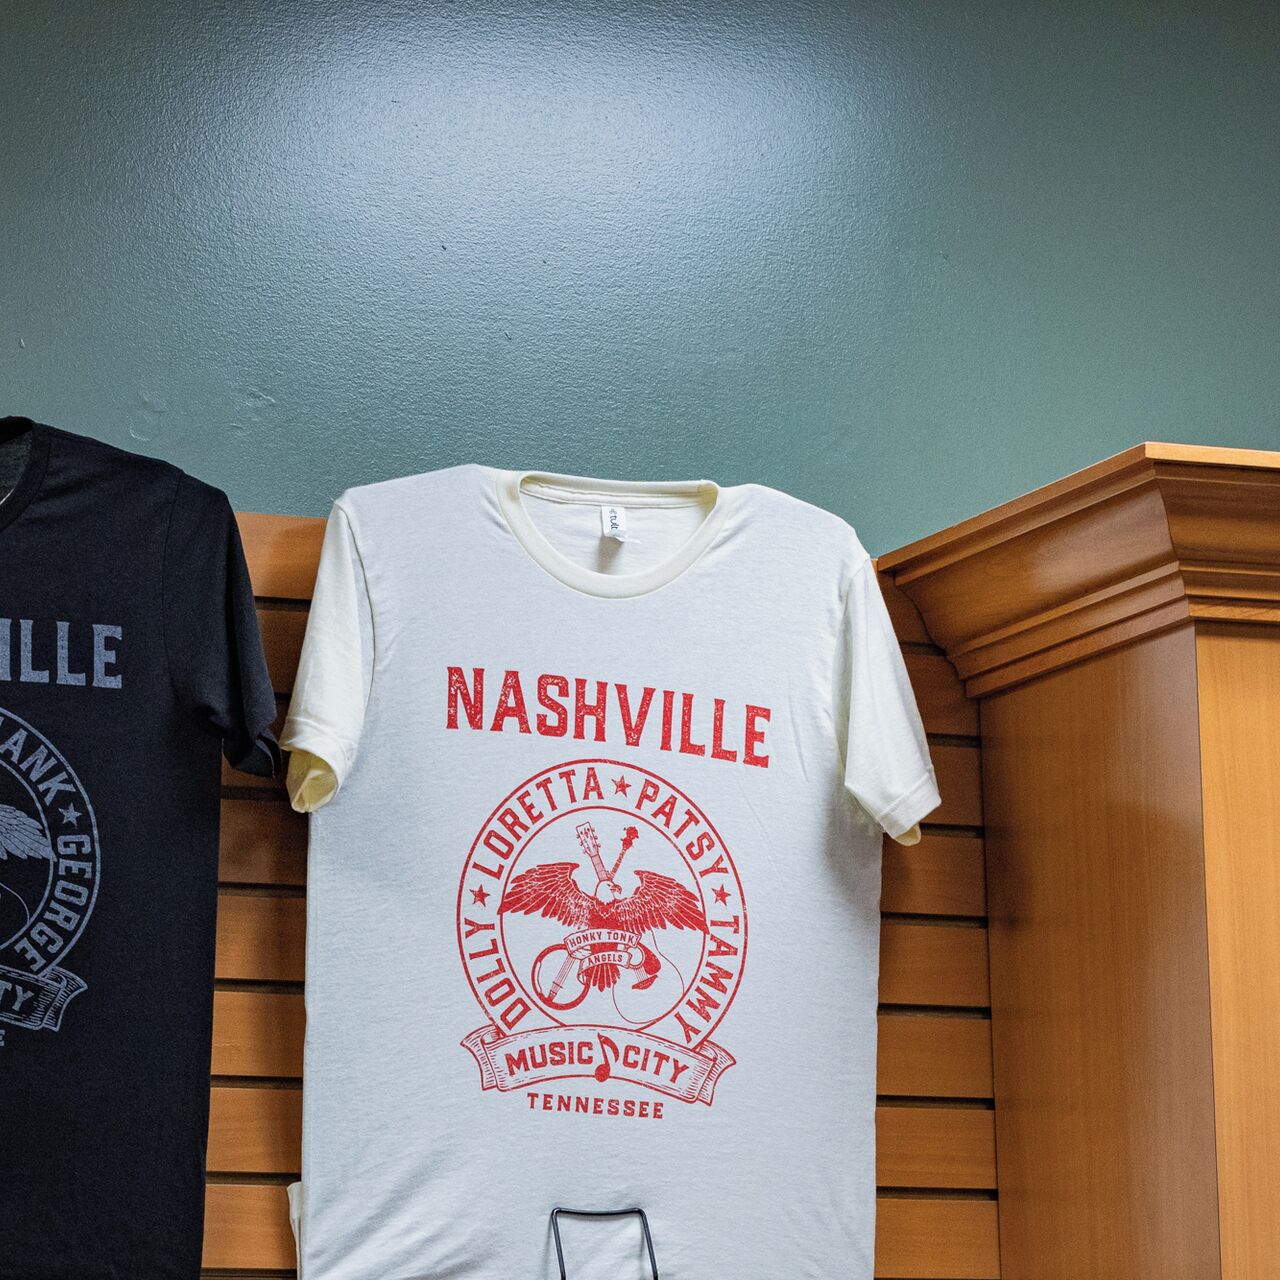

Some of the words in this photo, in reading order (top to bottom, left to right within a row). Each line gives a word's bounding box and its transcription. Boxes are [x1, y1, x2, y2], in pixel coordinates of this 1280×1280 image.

[446, 666, 771, 768] NASHVILLE
[472, 767, 604, 880] LORETTA
[635, 778, 729, 882] PATSY
[13, 834, 92, 970] GEORGE
[464, 918, 532, 1032] DOLLY
[588, 954, 623, 965] ANGELS
[675, 916, 740, 1044] TAMMY
[505, 1041, 594, 1076] MUSIC
[623, 1046, 689, 1083] CITY
[528, 1093, 664, 1119] TENNESSEE
